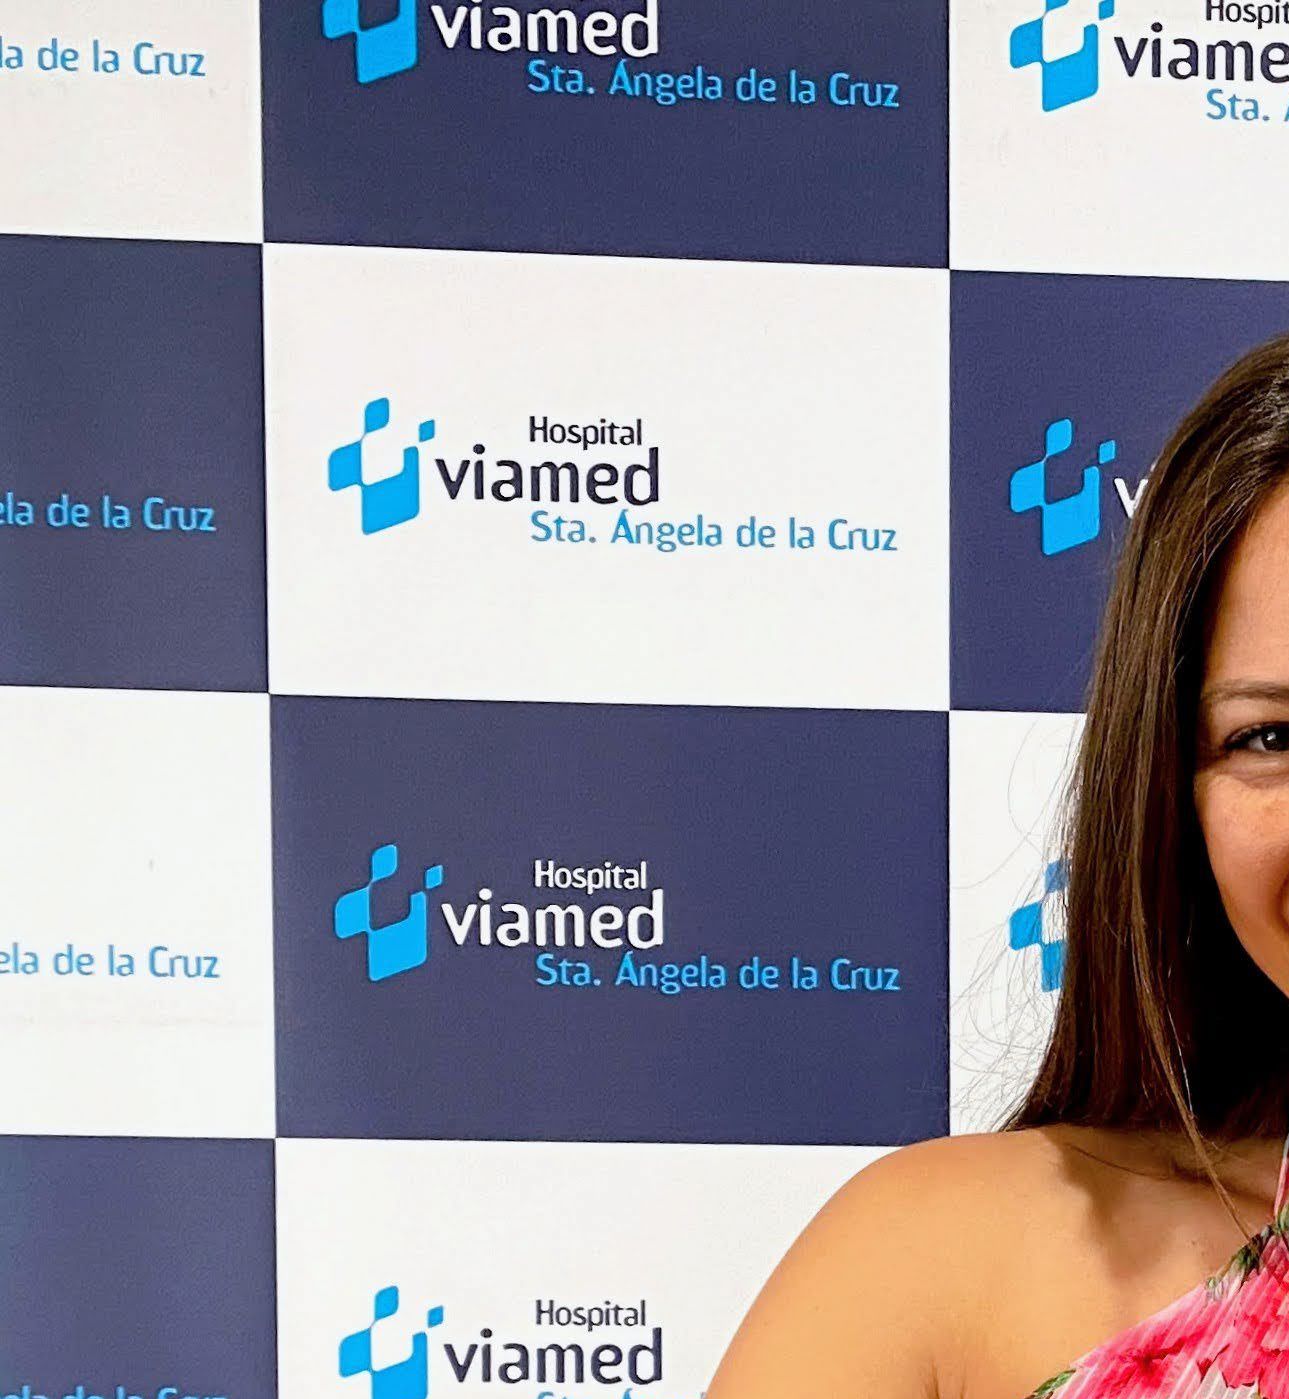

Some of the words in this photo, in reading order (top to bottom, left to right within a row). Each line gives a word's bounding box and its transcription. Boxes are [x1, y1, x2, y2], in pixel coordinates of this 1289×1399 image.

[430, 0, 659, 58] viamed
[37, 39, 80, 72] de
[92, 40, 121, 73] la
[132, 41, 206, 78] Cruz
[526, 58, 595, 95] Sta.
[607, 60, 723, 105] Ángela
[735, 68, 778, 102] de
[788, 70, 818, 105] la
[828, 71, 899, 109] Cruz
[1205, 87, 1270, 122] Sta.
[529, 415, 642, 451] Hospital
[434, 443, 659, 507] viamed
[46, 496, 91, 528] de
[101, 496, 131, 529] la
[141, 496, 214, 533] Cruz
[528, 509, 597, 544] Sta.
[611, 509, 723, 551] Ángela
[736, 518, 775, 548] de
[788, 517, 816, 549] la
[827, 518, 896, 552] Cruz
[534, 859, 647, 895] Hospital
[441, 887, 664, 951] viamed
[53, 947, 95, 976] de
[107, 945, 135, 976] la
[148, 945, 219, 979] Cruz
[535, 952, 602, 987] Sta.
[615, 952, 729, 995] Ángela
[738, 958, 781, 989] de
[790, 956, 820, 991] la
[829, 957, 900, 992] Cruz
[535, 1299, 646, 1333] Hospital
[443, 1326, 663, 1386] viamed
